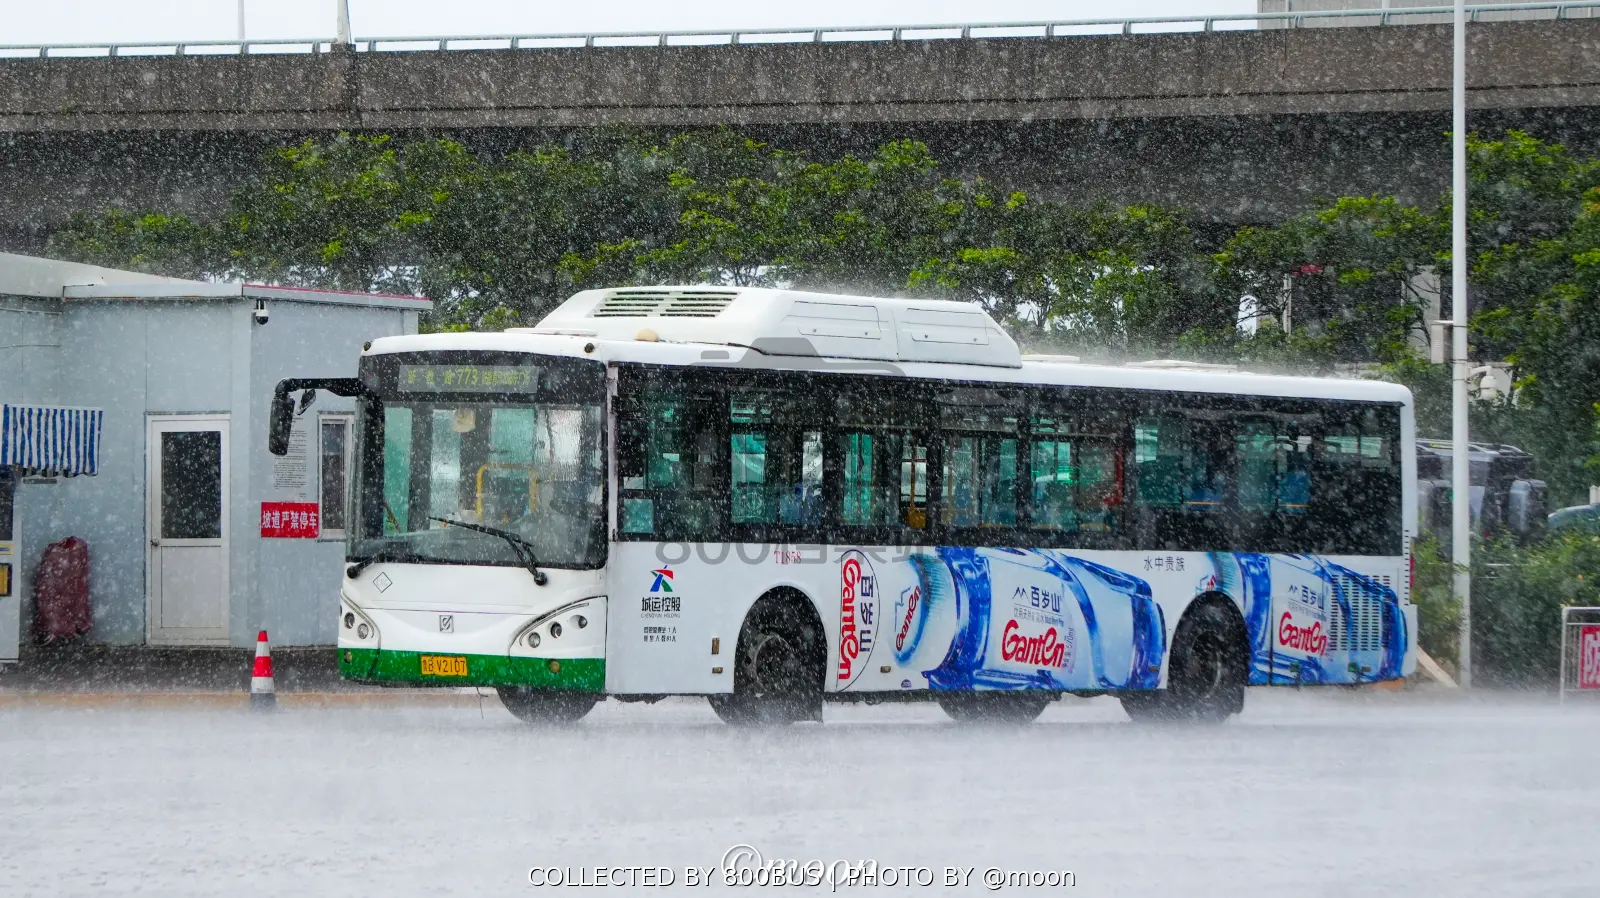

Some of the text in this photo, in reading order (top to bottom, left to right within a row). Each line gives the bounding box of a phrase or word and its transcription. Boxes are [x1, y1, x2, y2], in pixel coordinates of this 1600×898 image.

[457, 368, 478, 385] 773
[261, 511, 318, 529] 坡道严禁停车
[773, 550, 802, 565] T1858
[1143, 555, 1186, 572] 水中贵族
[641, 596, 681, 612] 城运控股
[1030, 585, 1061, 613] 百岁山
[838, 559, 861, 680] Ganten
[859, 575, 874, 653] 百岁山
[1001, 619, 1065, 668] Ganten
[1278, 611, 1328, 657] Ganten
